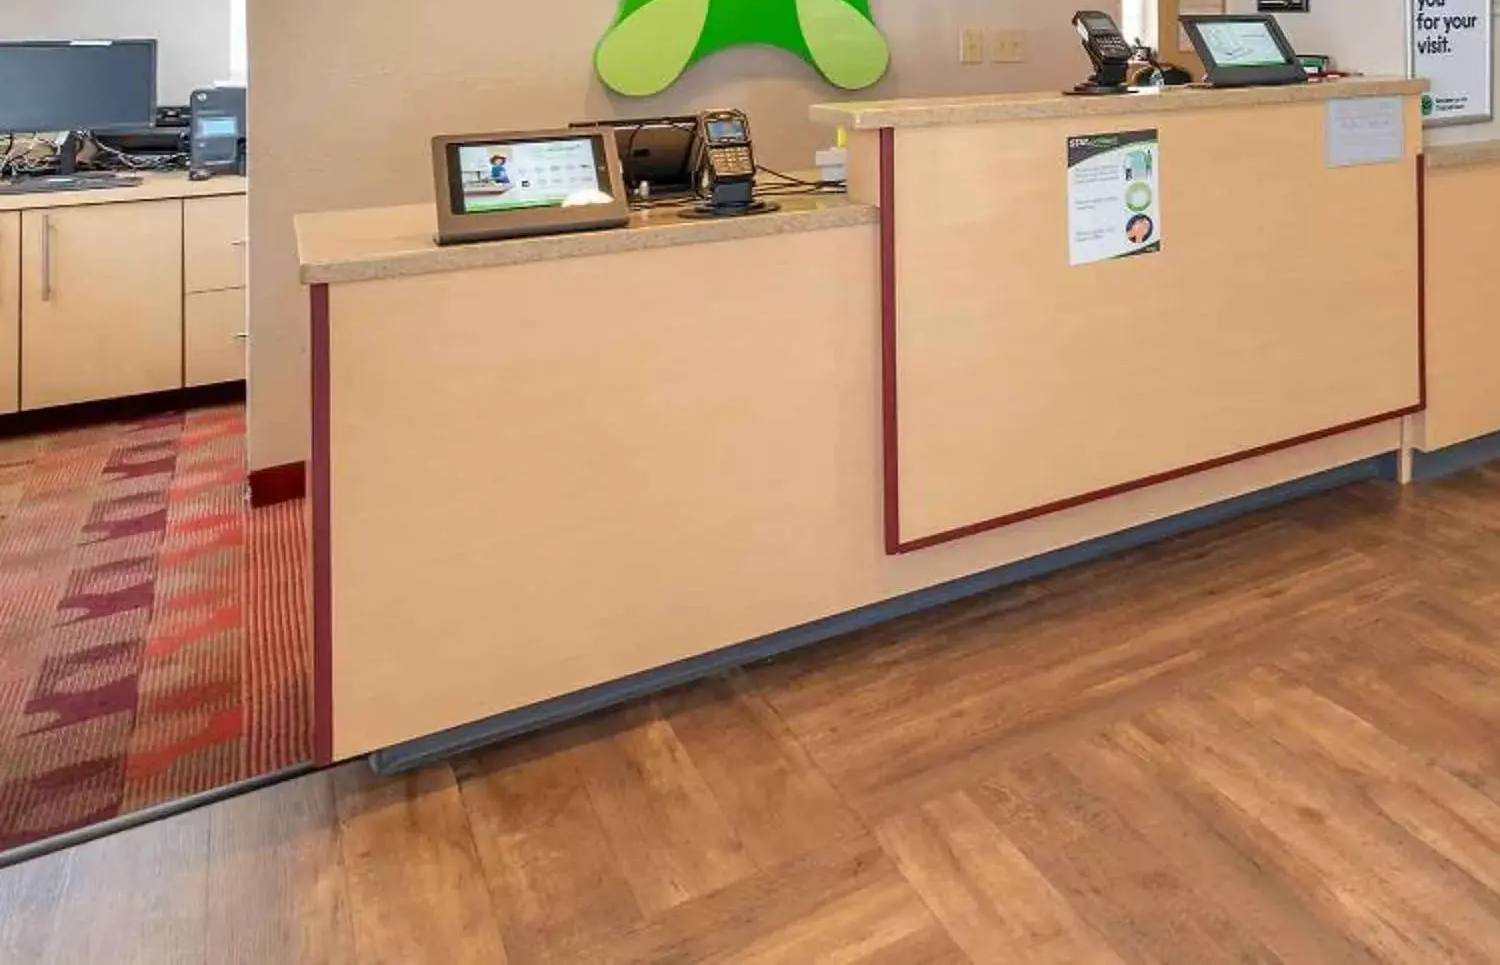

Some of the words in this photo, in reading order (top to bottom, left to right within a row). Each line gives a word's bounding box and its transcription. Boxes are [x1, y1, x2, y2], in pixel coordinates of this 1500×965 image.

[1416, 13, 1440, 31] for
[1443, 15, 1478, 34] your
[1417, 35, 1452, 54] visit.
